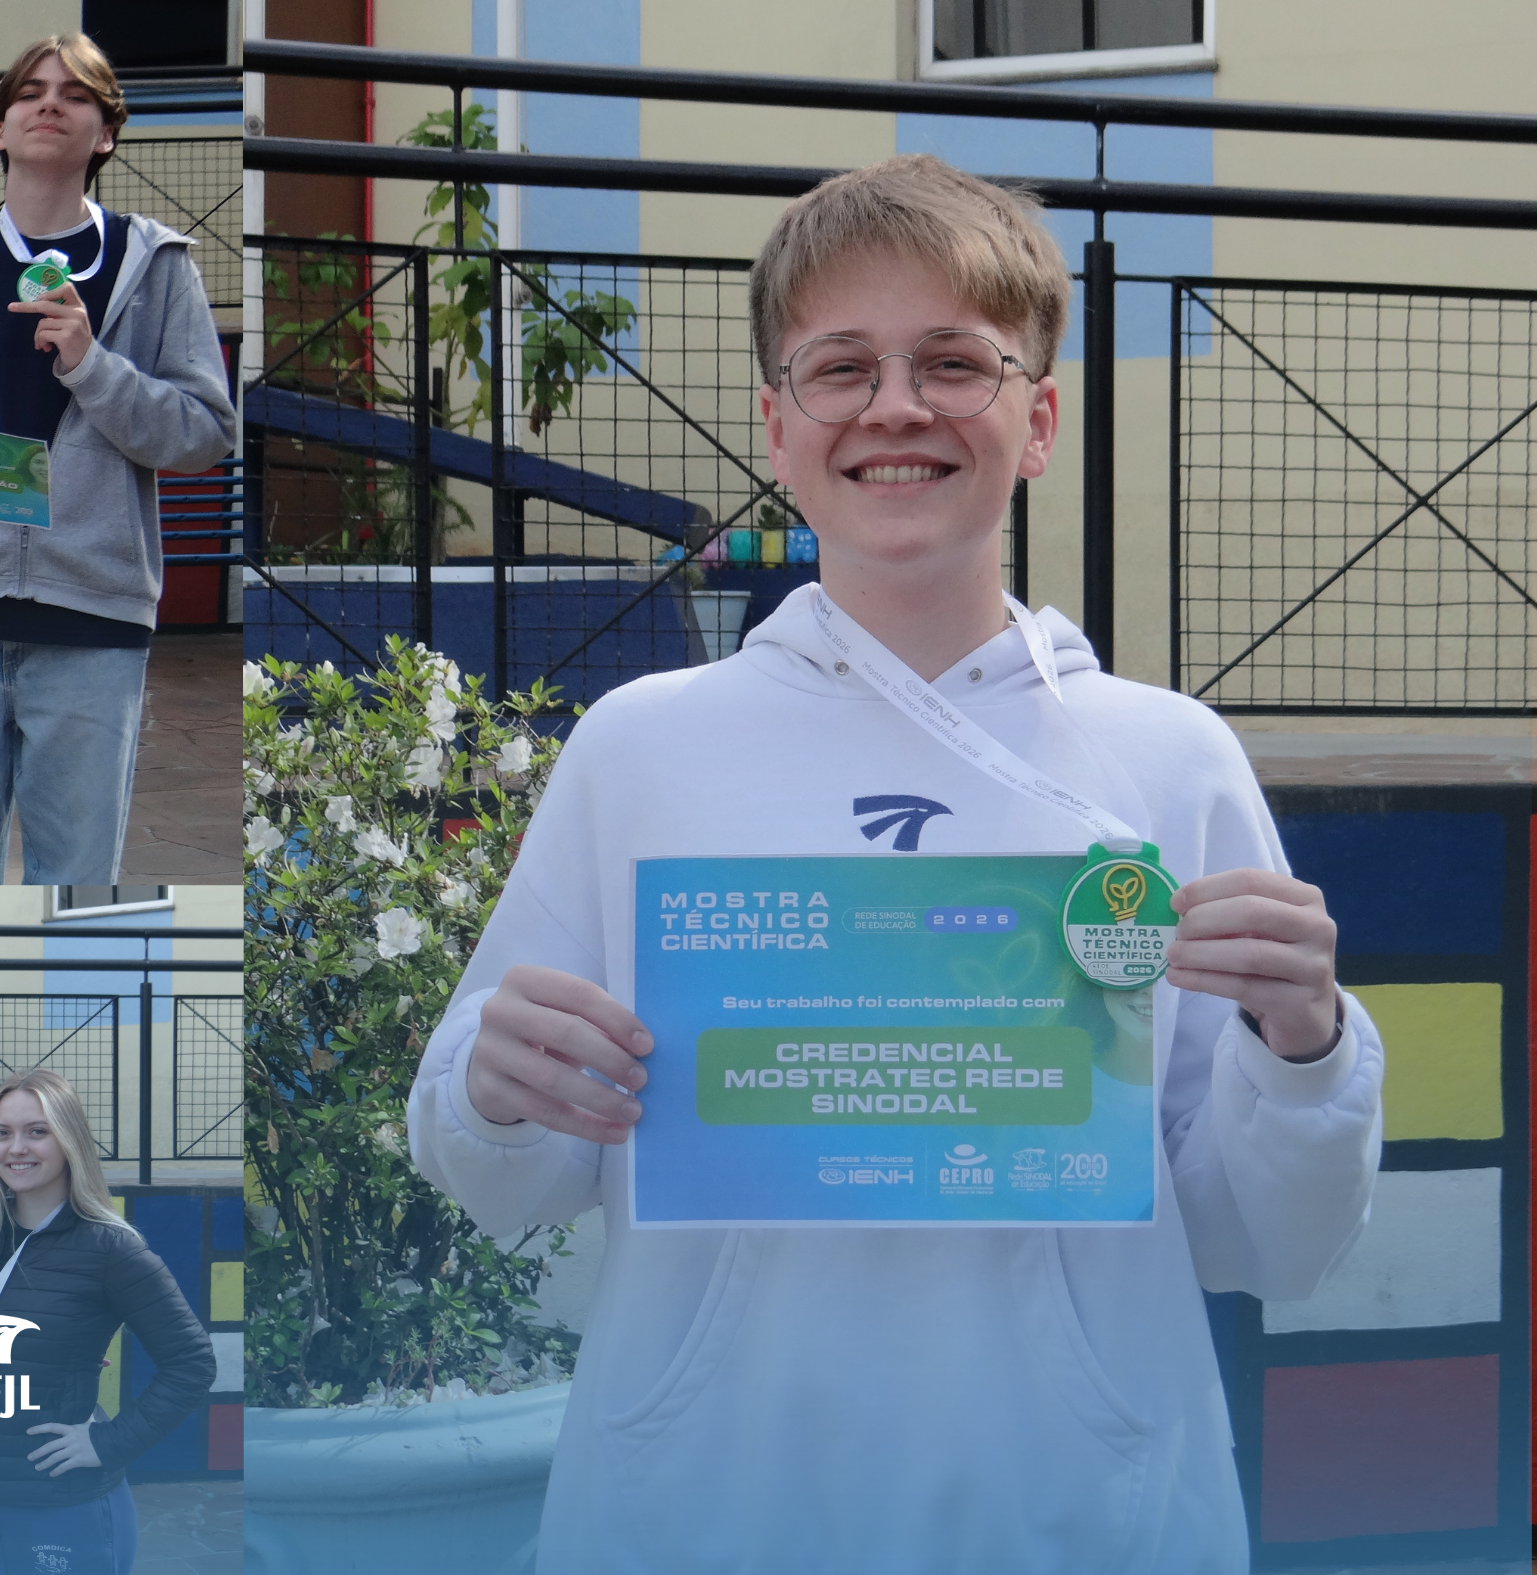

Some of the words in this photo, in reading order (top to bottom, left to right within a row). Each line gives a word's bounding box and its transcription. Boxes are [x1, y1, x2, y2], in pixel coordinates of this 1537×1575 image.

[832, 634, 851, 654] 2026
[862, 661, 889, 687] Mostra
[890, 684, 920, 713] Técnico
[920, 711, 959, 744] Científica
[958, 741, 982, 759] 2026
[919, 693, 961, 728] IENH
[988, 763, 1017, 783] Mostra
[1018, 781, 1050, 800] Técnico
[1050, 798, 1090, 820] Científica
[1089, 818, 1114, 840] 2026
[1049, 788, 1092, 810] IENH
[660, 891, 830, 909] MOSTRA
[660, 909, 830, 930] TÉCNICO
[854, 911, 877, 920] REDE
[879, 911, 917, 921] SINODAL
[933, 914, 1009, 925] 2026
[854, 920, 866, 930] DE
[868, 920, 917, 931] EDUCAÇÃO
[1084, 927, 1161, 938] MOSTRA
[660, 930, 830, 951] CIENTÍFICA
[1083, 937, 1164, 950] TÉCNICO
[1083, 950, 1162, 960] CIENTÍFICA
[1127, 966, 1153, 974] 2026
[722, 996, 763, 1010] Seu
[766, 996, 853, 1009] trabalho
[856, 996, 883, 1009] foi
[886, 996, 1019, 1012] contemplado
[1022, 998, 1065, 1009] com
[775, 1042, 1013, 1062] CREDENCIAL
[724, 1067, 957, 1089] MOSTRATEC
[965, 1067, 1064, 1088] REDE
[811, 1094, 977, 1114] SINODAL
[863, 1155, 913, 1163] TÉCNICOS
[1060, 1153, 1108, 1179] 200
[848, 1169, 913, 1184] IENH
[939, 1167, 994, 1184] CEPRO
[1023, 1172, 1053, 1181] SINODAL
[31, 1544, 72, 1553] COMDICA
